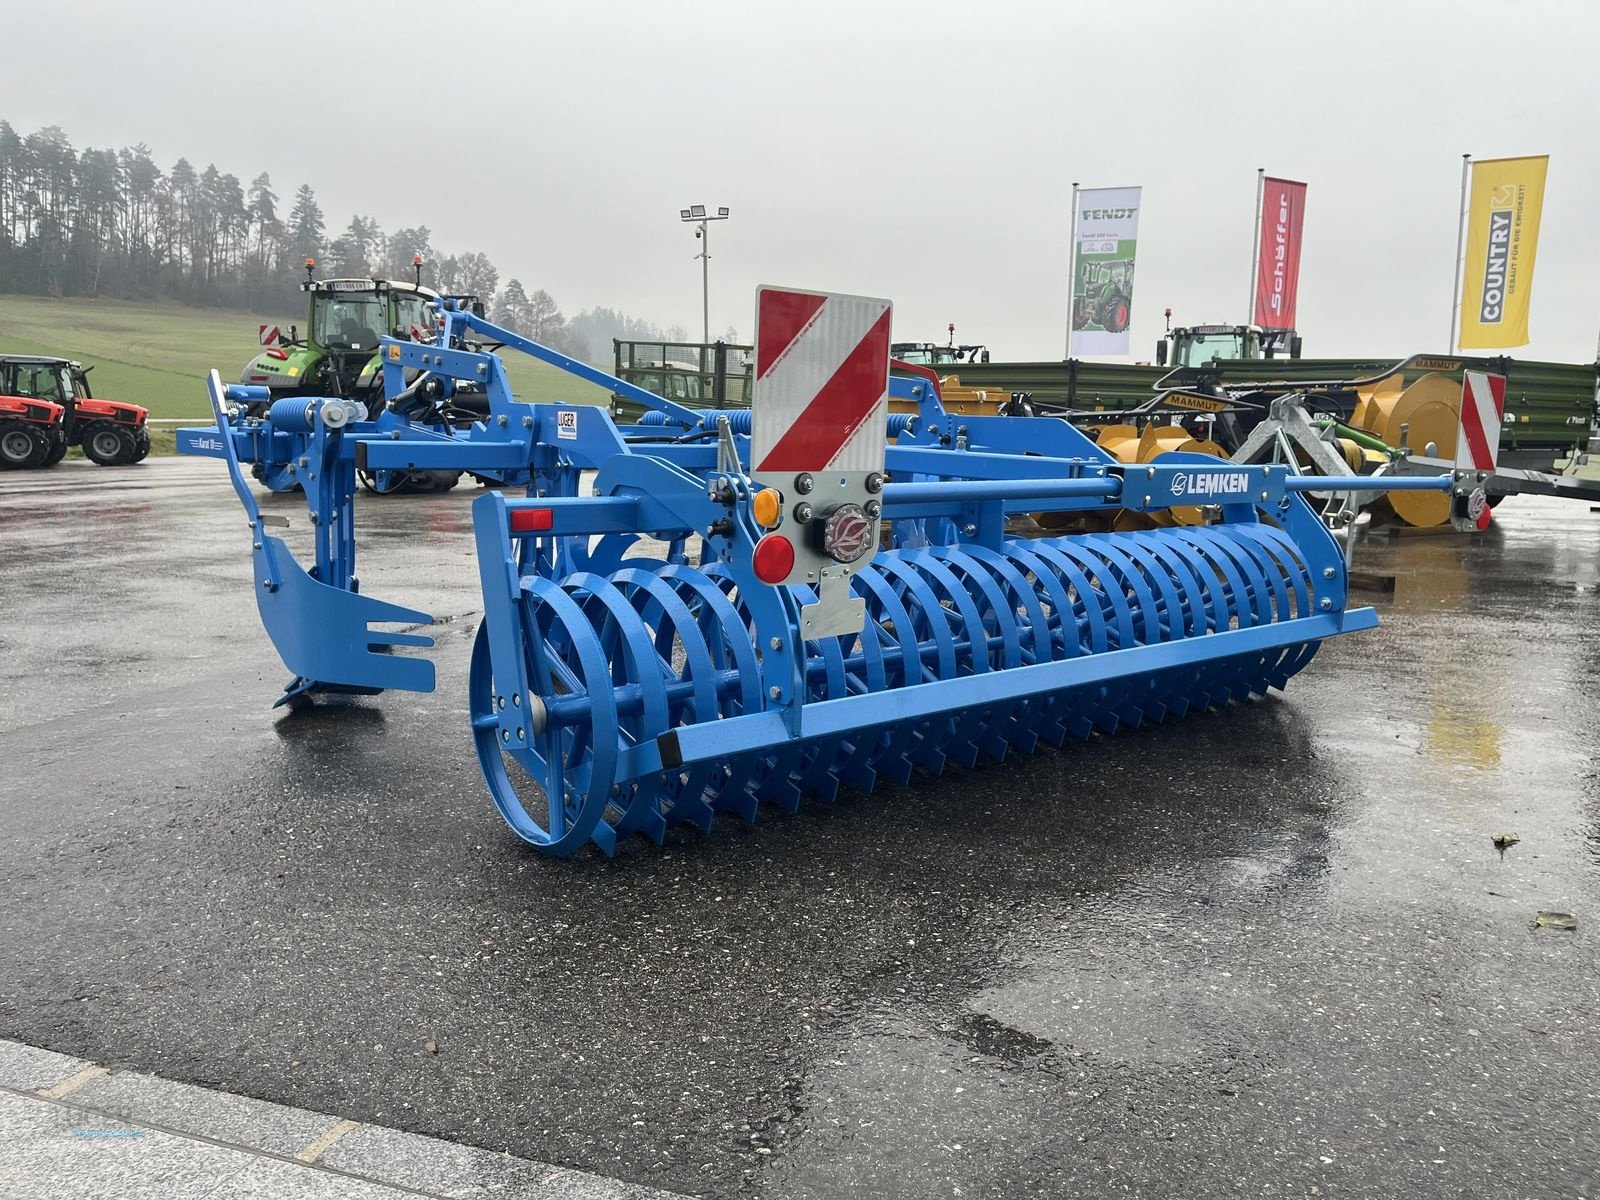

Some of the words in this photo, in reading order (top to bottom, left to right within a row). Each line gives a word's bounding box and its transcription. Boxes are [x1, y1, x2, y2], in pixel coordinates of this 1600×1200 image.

[1082, 208, 1137, 220] FENDT
[1271, 193, 1288, 317] Schäffer
[1483, 214, 1511, 321] COUNTRY
[1509, 263, 1518, 295] GEBAUT
[1415, 360, 1457, 369] MAMMUT
[1171, 395, 1219, 411] MAMMUT
[558, 413, 575, 427] LUGER
[1187, 473, 1249, 499] LEMKEN
